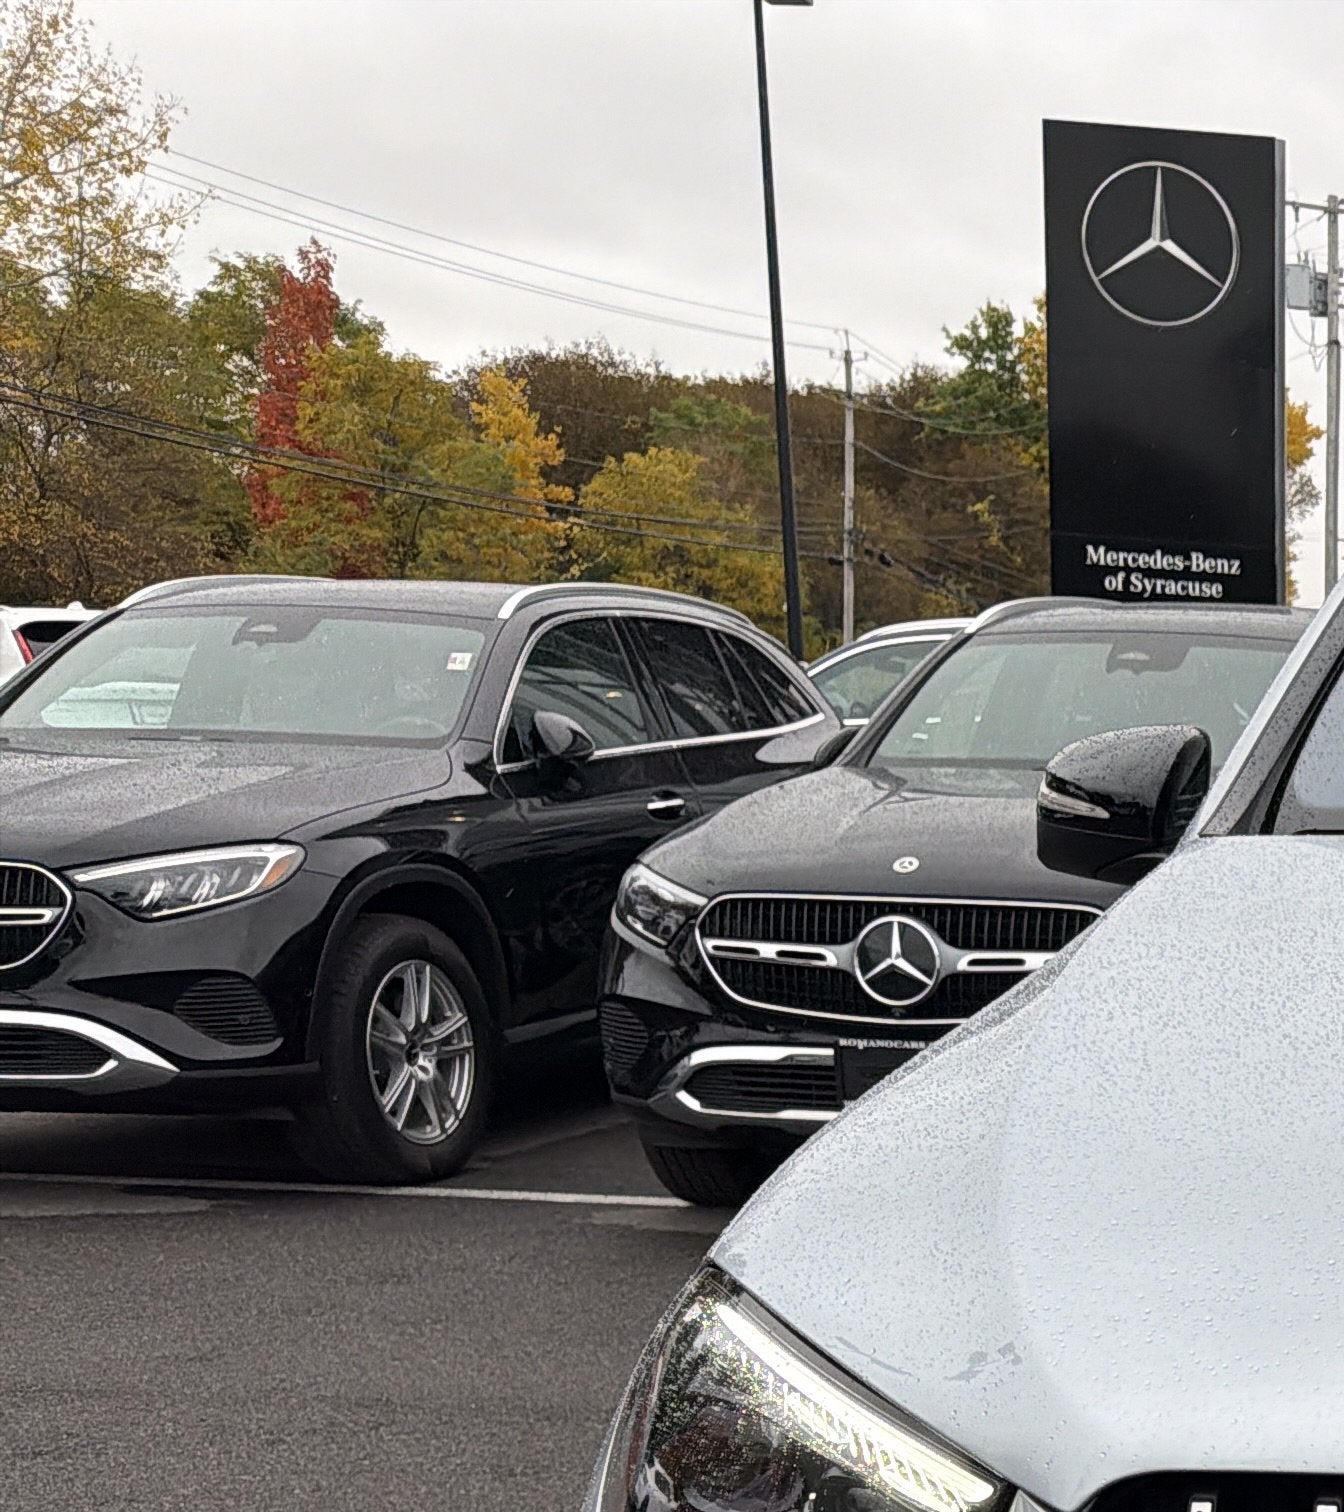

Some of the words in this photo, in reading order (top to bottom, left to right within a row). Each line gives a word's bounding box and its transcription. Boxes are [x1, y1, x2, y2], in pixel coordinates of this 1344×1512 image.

[1086, 545, 1241, 575] Mercedes-Benz
[1105, 571, 1126, 591] of
[1130, 573, 1223, 598] Syracuse
[839, 1039, 925, 1049] ROMANOCARS
